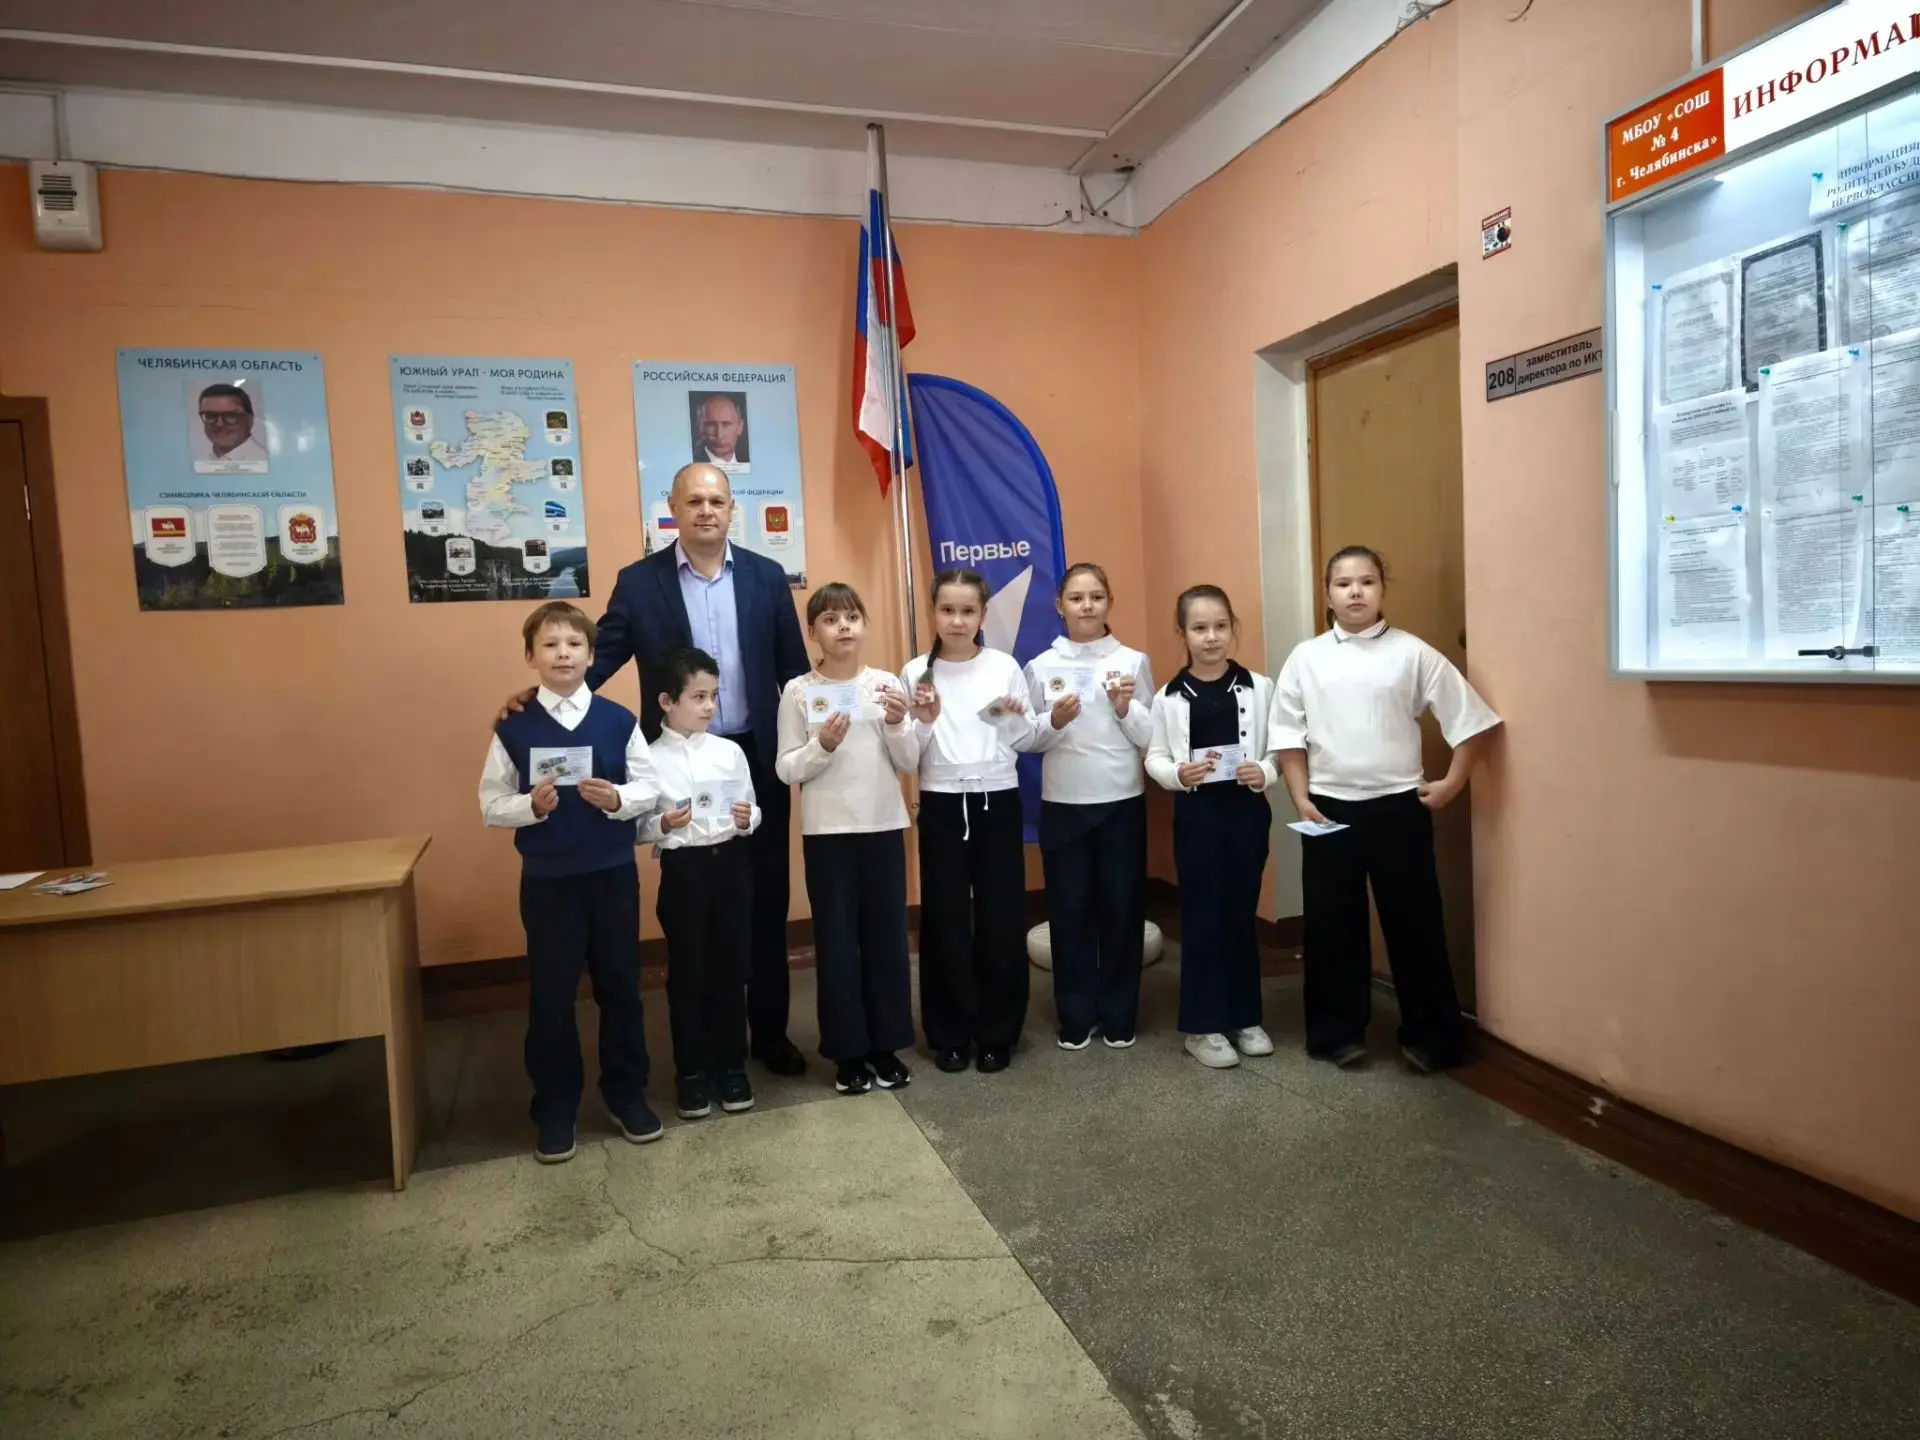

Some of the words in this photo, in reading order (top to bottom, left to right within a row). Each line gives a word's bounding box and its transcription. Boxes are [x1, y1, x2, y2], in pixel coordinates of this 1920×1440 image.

[1622, 113, 1662, 145] МБОУ
[1667, 89, 1710, 121] «СОШ
[1650, 134, 1666, 151] №
[1670, 126, 1680, 142] 4
[1616, 177, 1626, 188] г.
[1629, 135, 1718, 180] Челябинска»
[137, 357, 237, 370] ЧЕЛЯБИНСКАЯ
[241, 360, 303, 371] ОБЛАСТЬ
[1525, 341, 1593, 368] заместитель
[400, 366, 448, 377] ЮЖНЫЙ
[451, 367, 480, 377] УРАЛ
[490, 368, 515, 378] МОЯ
[518, 369, 564, 379] РОДИНА
[643, 370, 719, 382] РОССИЙСКАЯ
[722, 371, 786, 384] ФЕДЕРАЦИЯ
[1488, 367, 1514, 390] 208
[1517, 363, 1567, 385] директора
[1569, 358, 1582, 369] по
[940, 540, 1031, 566] Первые
